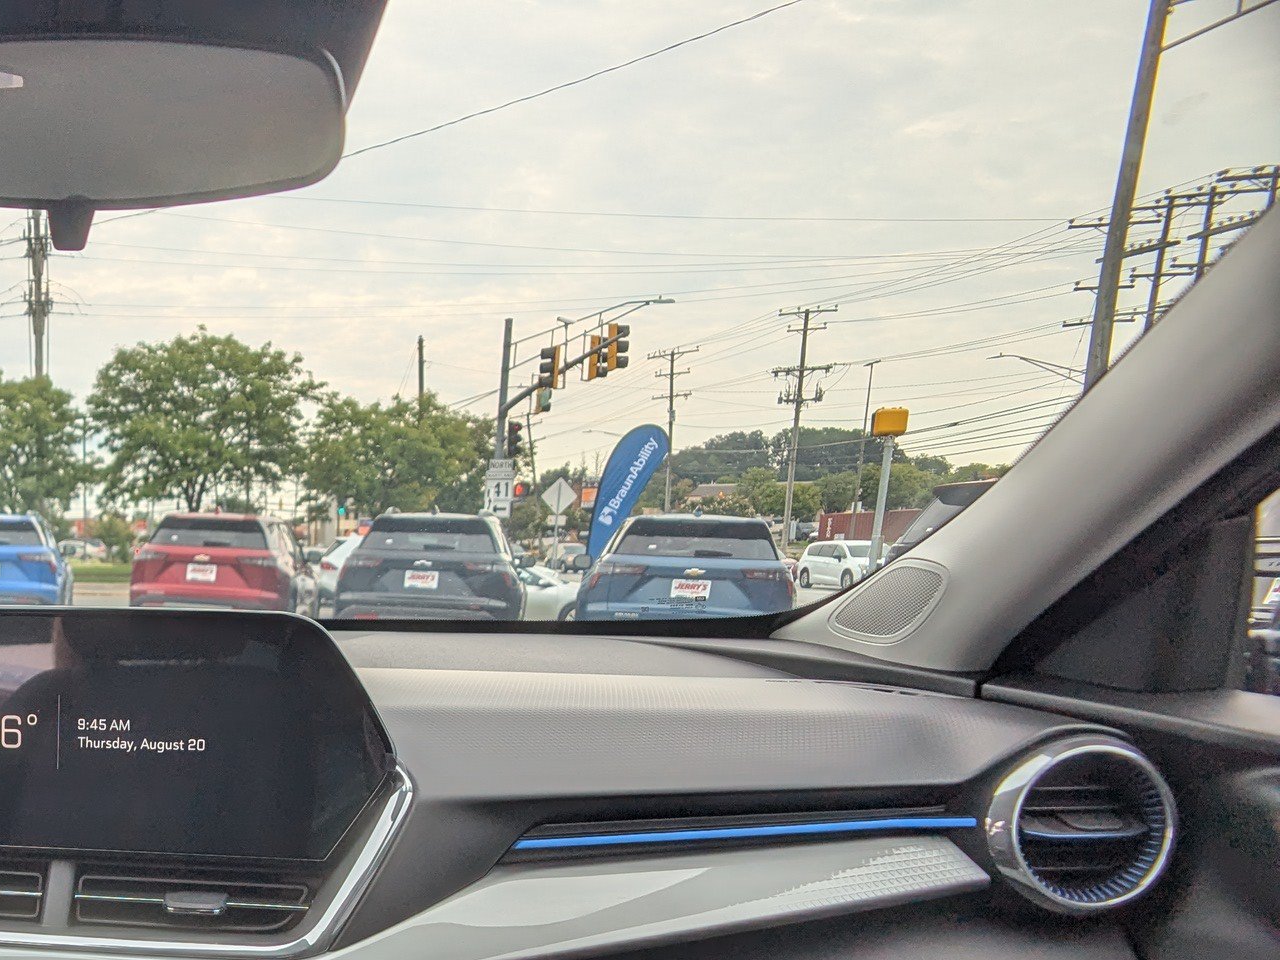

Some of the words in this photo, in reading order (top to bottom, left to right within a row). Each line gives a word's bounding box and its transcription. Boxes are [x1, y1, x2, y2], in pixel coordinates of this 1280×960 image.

[491, 460, 512, 469] NORTH
[608, 437, 658, 510] BraunAbility
[494, 481, 510, 497] 41
[674, 581, 708, 591] JERRY'S
[77, 718, 107, 731] 9:45
[109, 718, 131, 731] AM
[77, 736, 137, 752] Thursday,
[140, 738, 185, 753] August
[187, 739, 206, 751] 20
